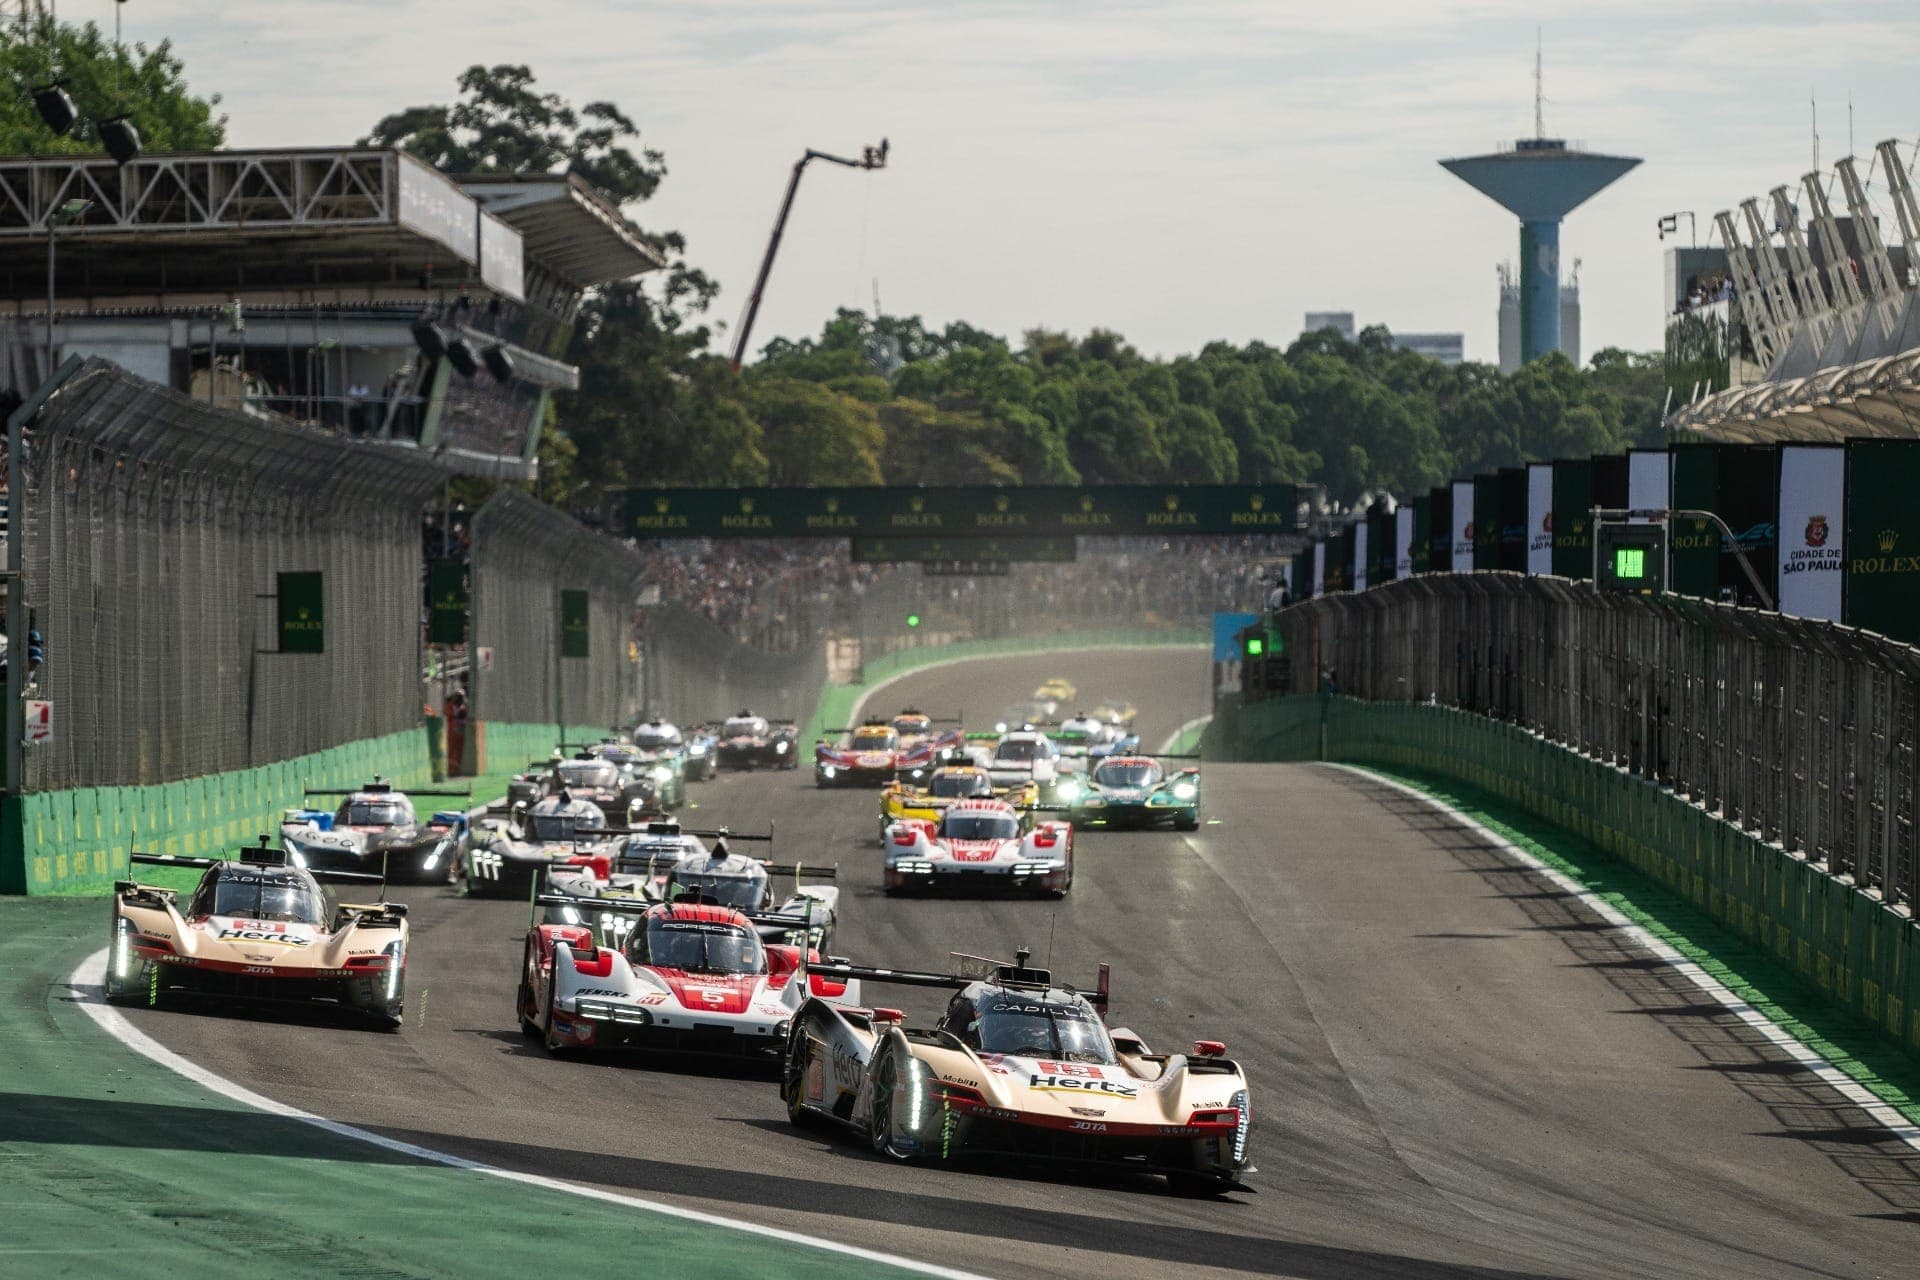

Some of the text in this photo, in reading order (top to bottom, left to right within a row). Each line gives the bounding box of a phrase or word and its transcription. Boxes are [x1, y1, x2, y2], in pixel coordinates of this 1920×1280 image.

[1675, 535, 1712, 549] ROLE
[1791, 549, 1841, 561] CIDADE DE
[1783, 560, 1805, 575] SÃO
[1852, 556, 1920, 574] ROLEX
[218, 929, 311, 946] Hertz
[241, 966, 275, 975] JOTA
[701, 990, 725, 1004] 5
[993, 1003, 1094, 1019] CADILL
[1029, 1074, 1137, 1097] Hertz
[1069, 1121, 1108, 1132] JOTA
